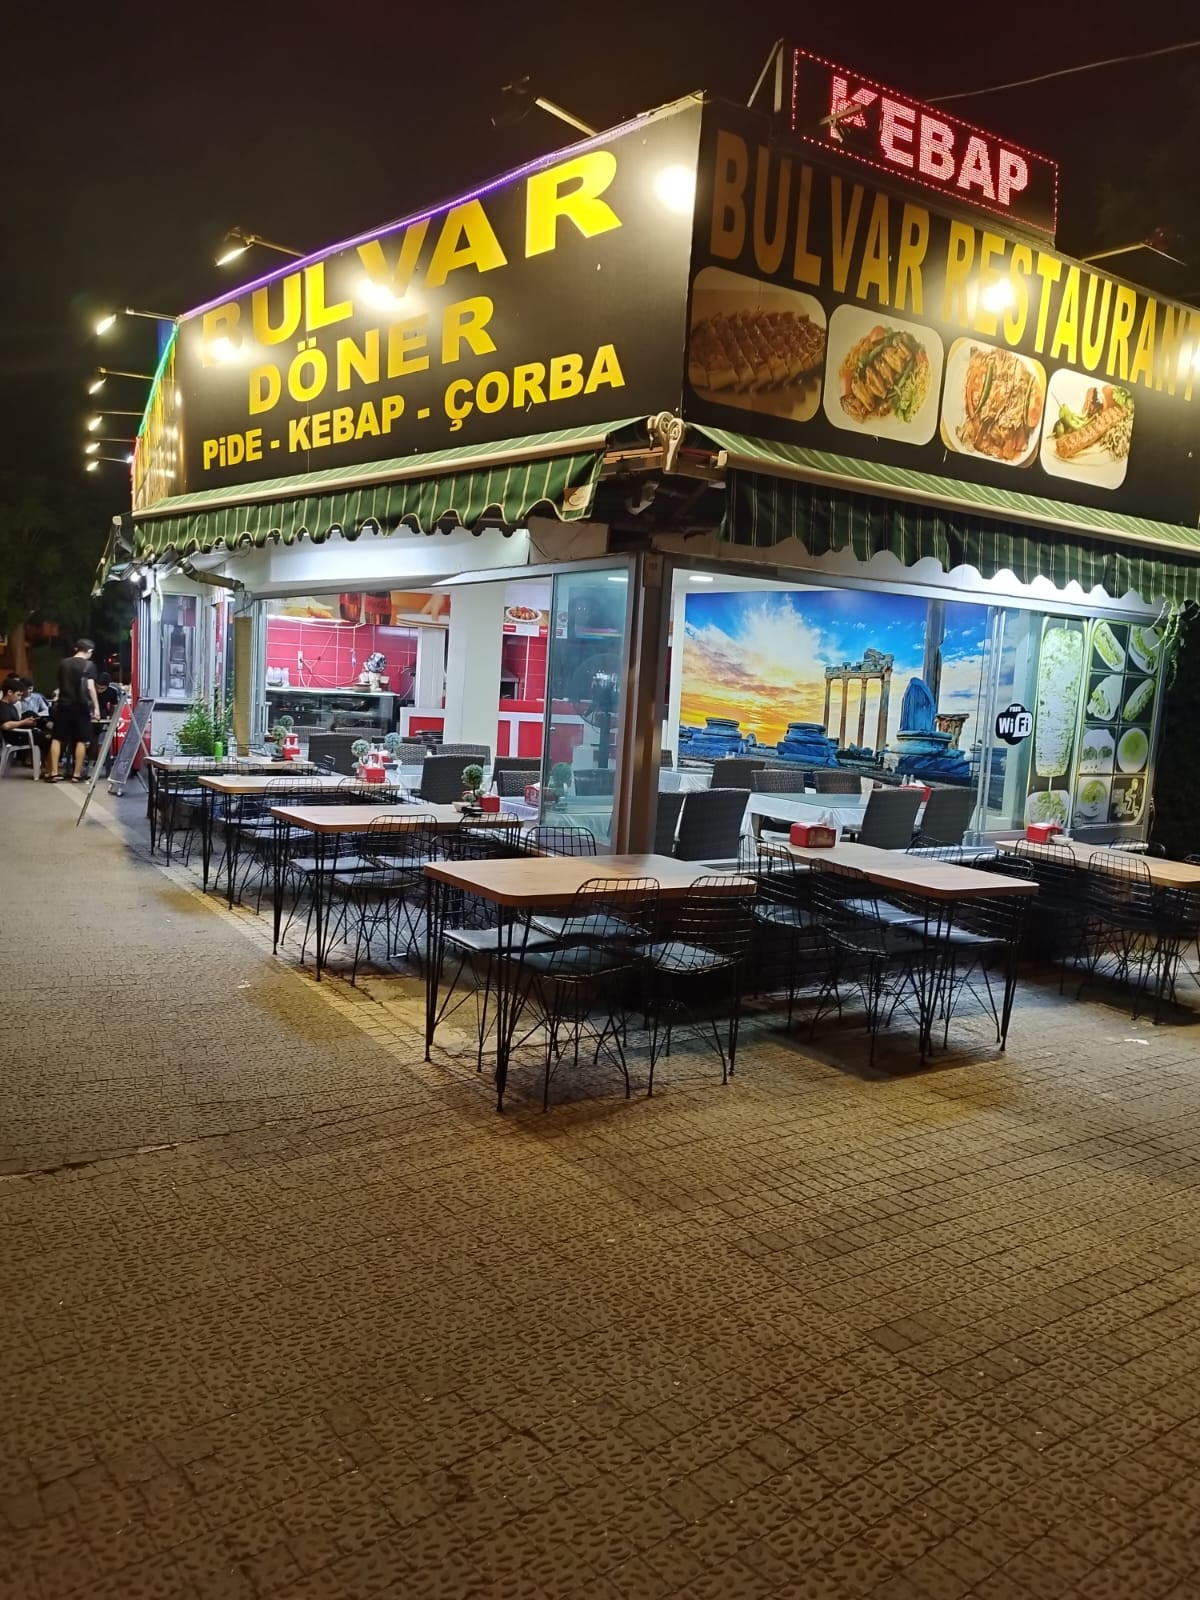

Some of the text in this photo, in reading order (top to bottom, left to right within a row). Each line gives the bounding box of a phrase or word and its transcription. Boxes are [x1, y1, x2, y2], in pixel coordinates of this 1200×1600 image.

[831, 75, 1029, 206] KEBAP
[203, 151, 623, 367] BULVAR
[710, 130, 930, 315] BULVAR
[248, 296, 497, 415] DÖNER
[288, 395, 405, 453] KEBAP
[445, 344, 625, 432] ÇORBA
